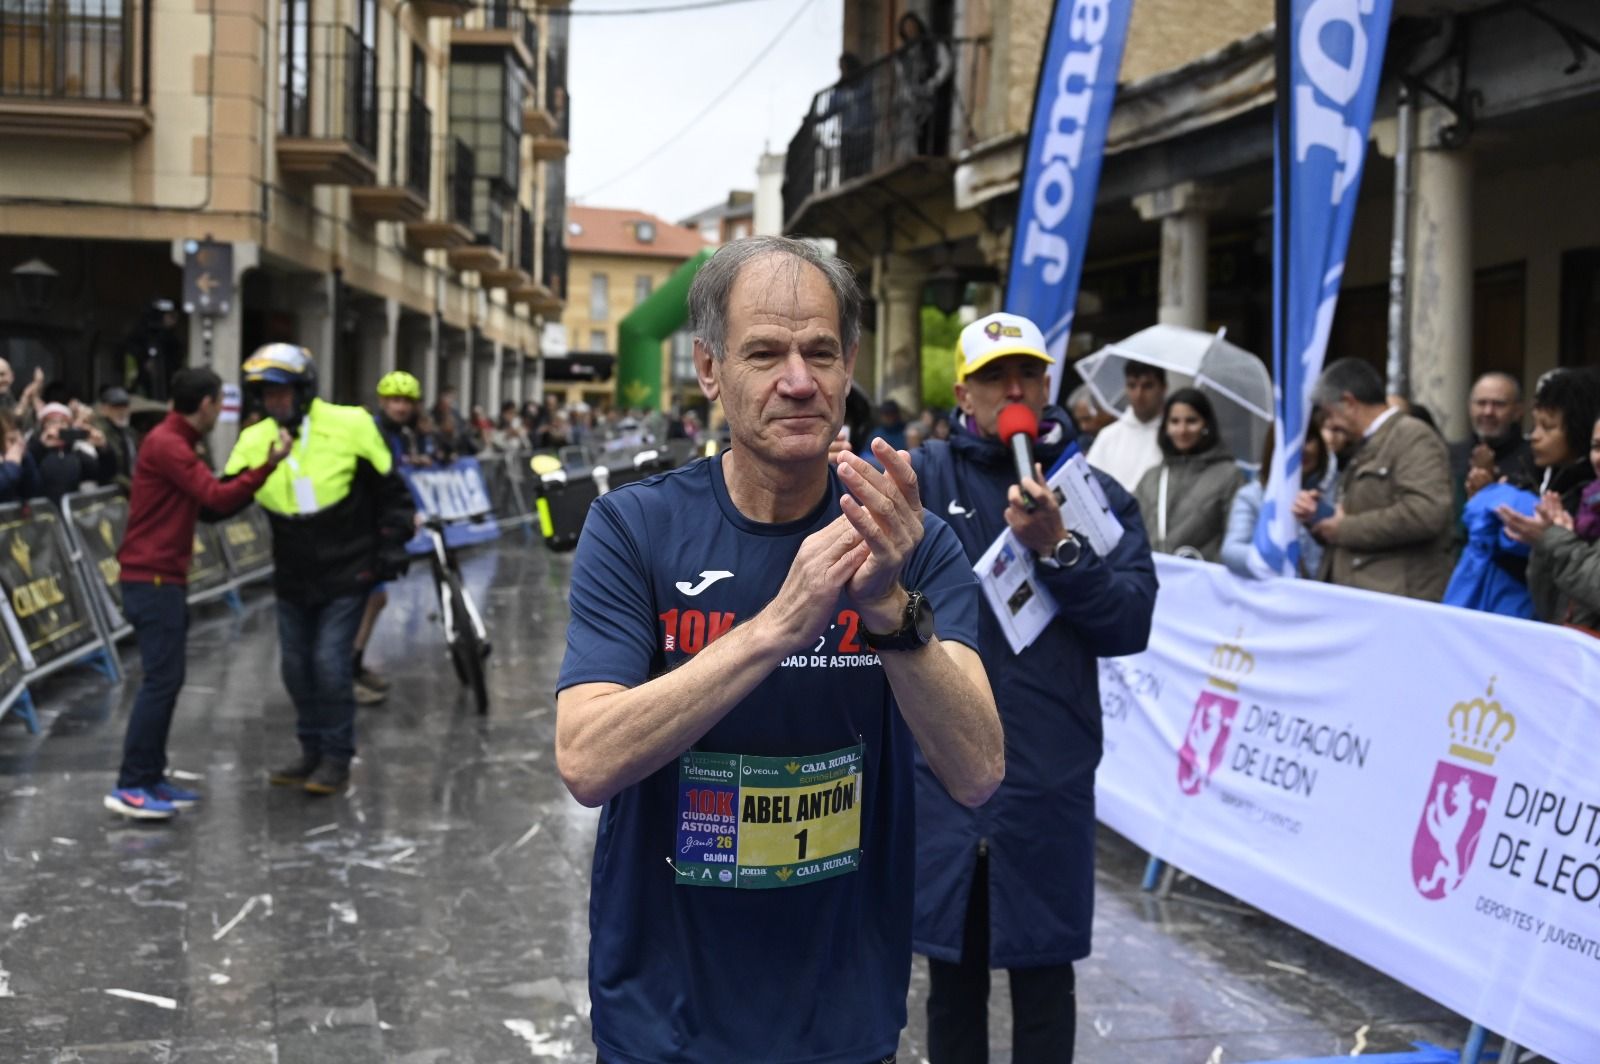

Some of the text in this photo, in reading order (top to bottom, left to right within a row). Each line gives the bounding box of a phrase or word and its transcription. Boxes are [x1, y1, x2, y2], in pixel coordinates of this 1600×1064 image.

[1295, 0, 1374, 205] Jo
[665, 634, 674, 650] XIV
[810, 655, 827, 668] DE
[829, 654, 882, 668] ASTORGA
[1243, 704, 1370, 769] DIPUTACIÓN
[683, 766, 734, 778] Telenauto
[801, 753, 858, 773] CAJA RURAL
[1232, 743, 1317, 797] DE LEÓN
[686, 789, 734, 816] 10K
[742, 781, 854, 823] ABEL ANTÓN
[1504, 782, 1600, 846] DIPUT
[681, 822, 736, 834] ASTORGA
[682, 811, 736, 823] CIUDAD DE
[716, 836, 732, 848] 26
[794, 828, 808, 860] 1
[703, 853, 735, 862] CAJÓN A
[796, 855, 854, 876] CAJA RURAL
[1489, 833, 1530, 878] DE
[1475, 895, 1534, 931] DEPORTES
[1535, 918, 1545, 935] Y
